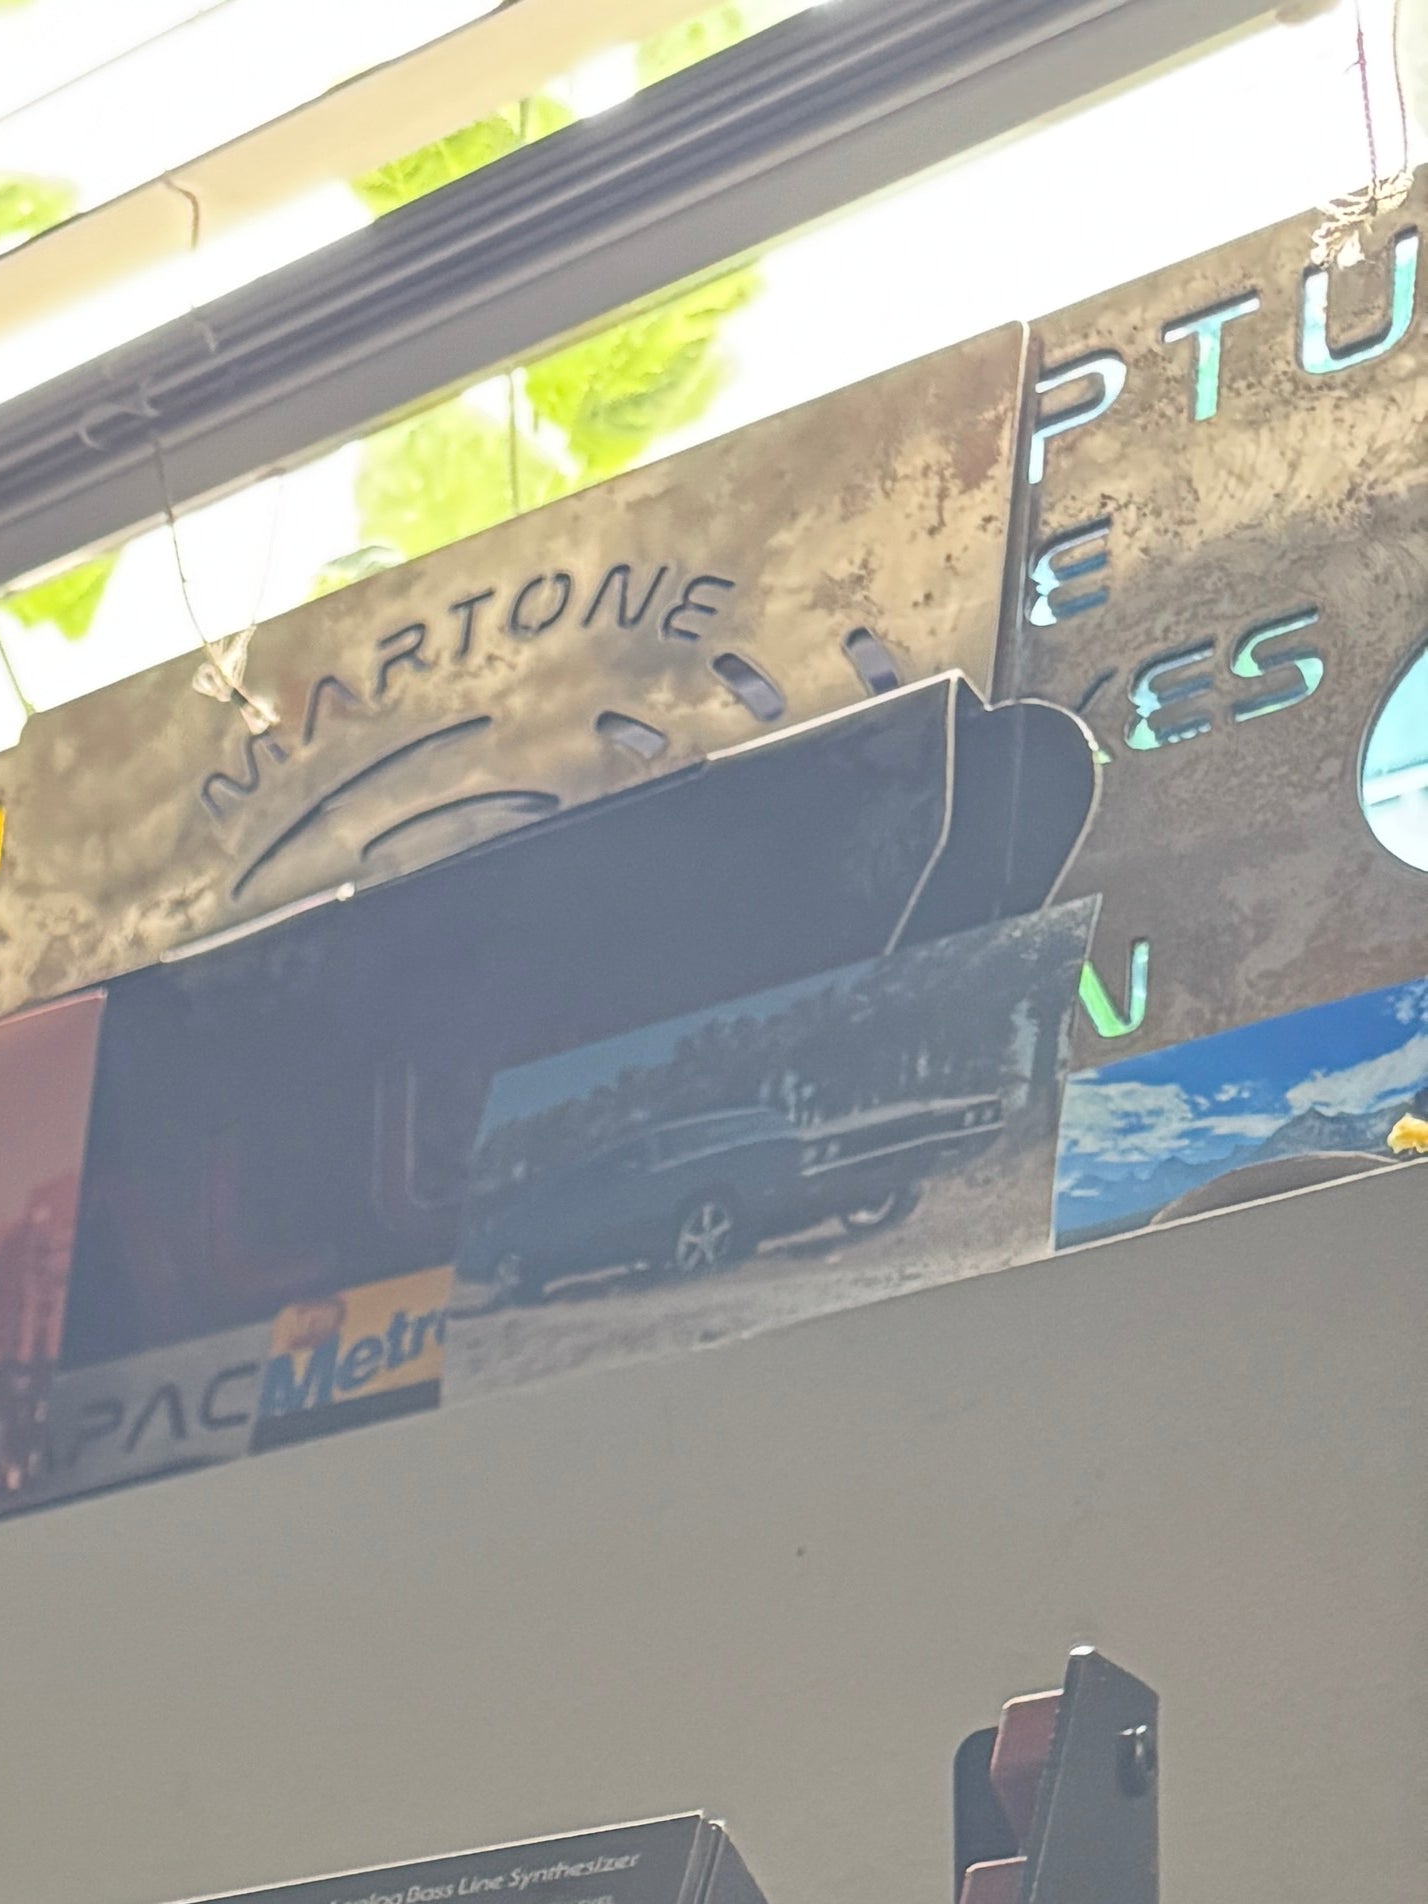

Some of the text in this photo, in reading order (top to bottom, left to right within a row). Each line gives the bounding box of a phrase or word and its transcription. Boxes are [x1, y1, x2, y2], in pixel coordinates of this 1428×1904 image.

[405, 1884, 455, 1904] Bass
[458, 1875, 504, 1895] Line
[507, 1853, 641, 1889] Synthesizer
